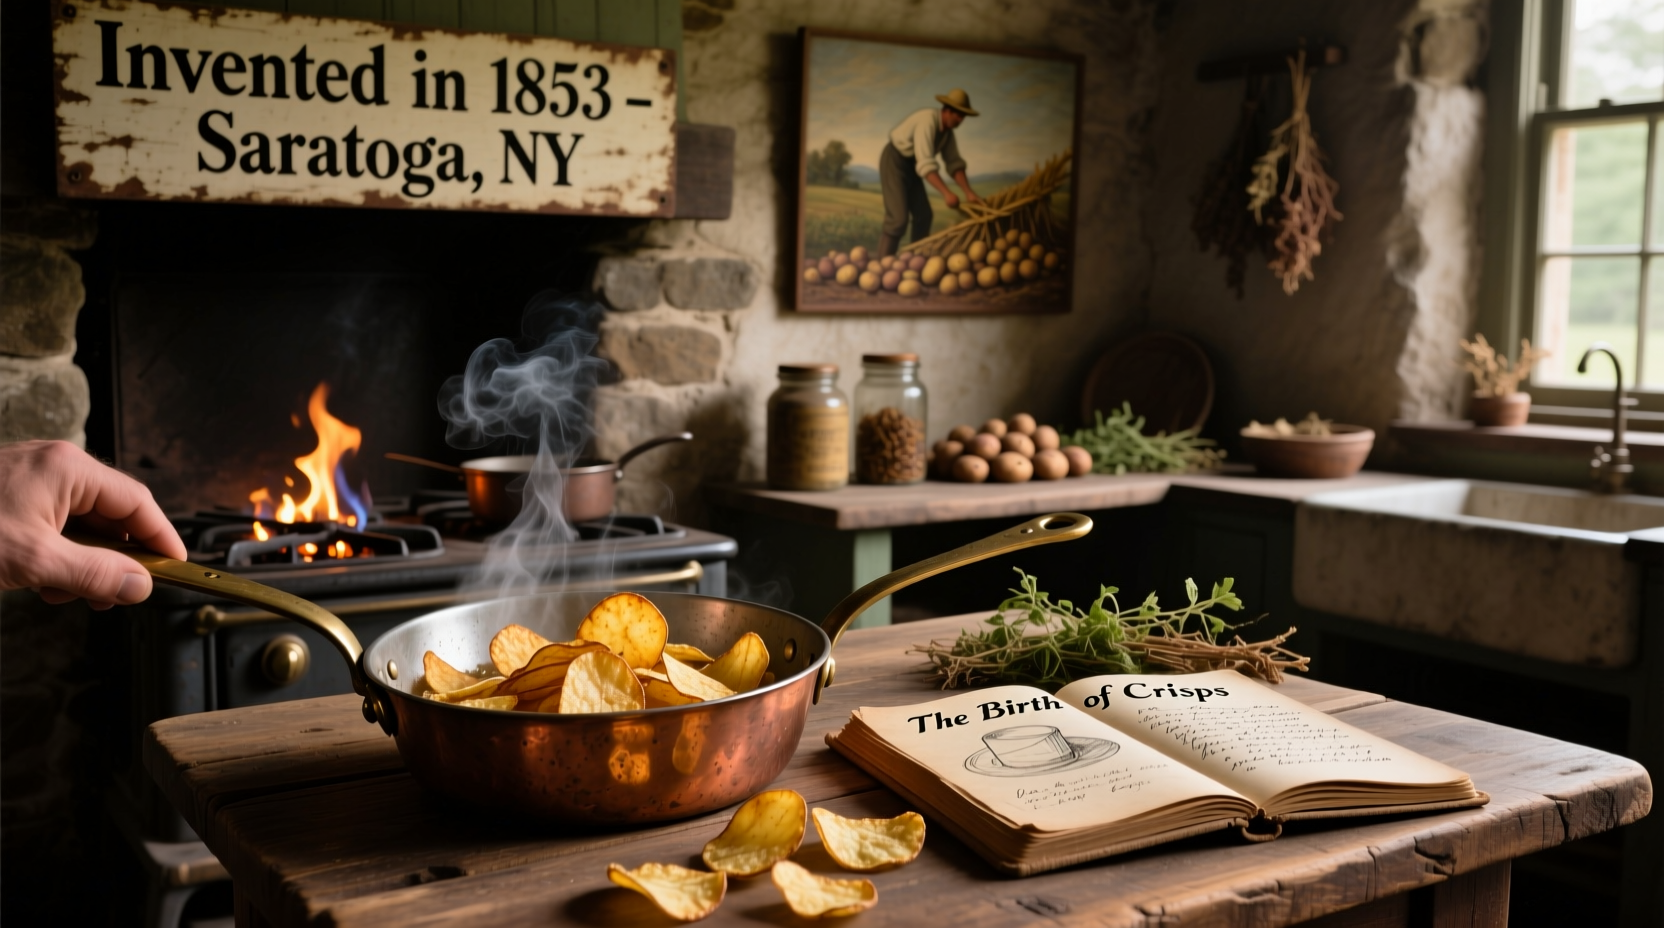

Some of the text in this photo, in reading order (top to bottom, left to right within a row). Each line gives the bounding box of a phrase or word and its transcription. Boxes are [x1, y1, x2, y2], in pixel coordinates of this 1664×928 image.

[95, 20, 389, 106] Invented
[412, 49, 468, 111] in
[491, 57, 612, 120] 1853
[198, 110, 584, 198] Saratoga, NY
[907, 683, 1230, 734] The Birth of Crisps
